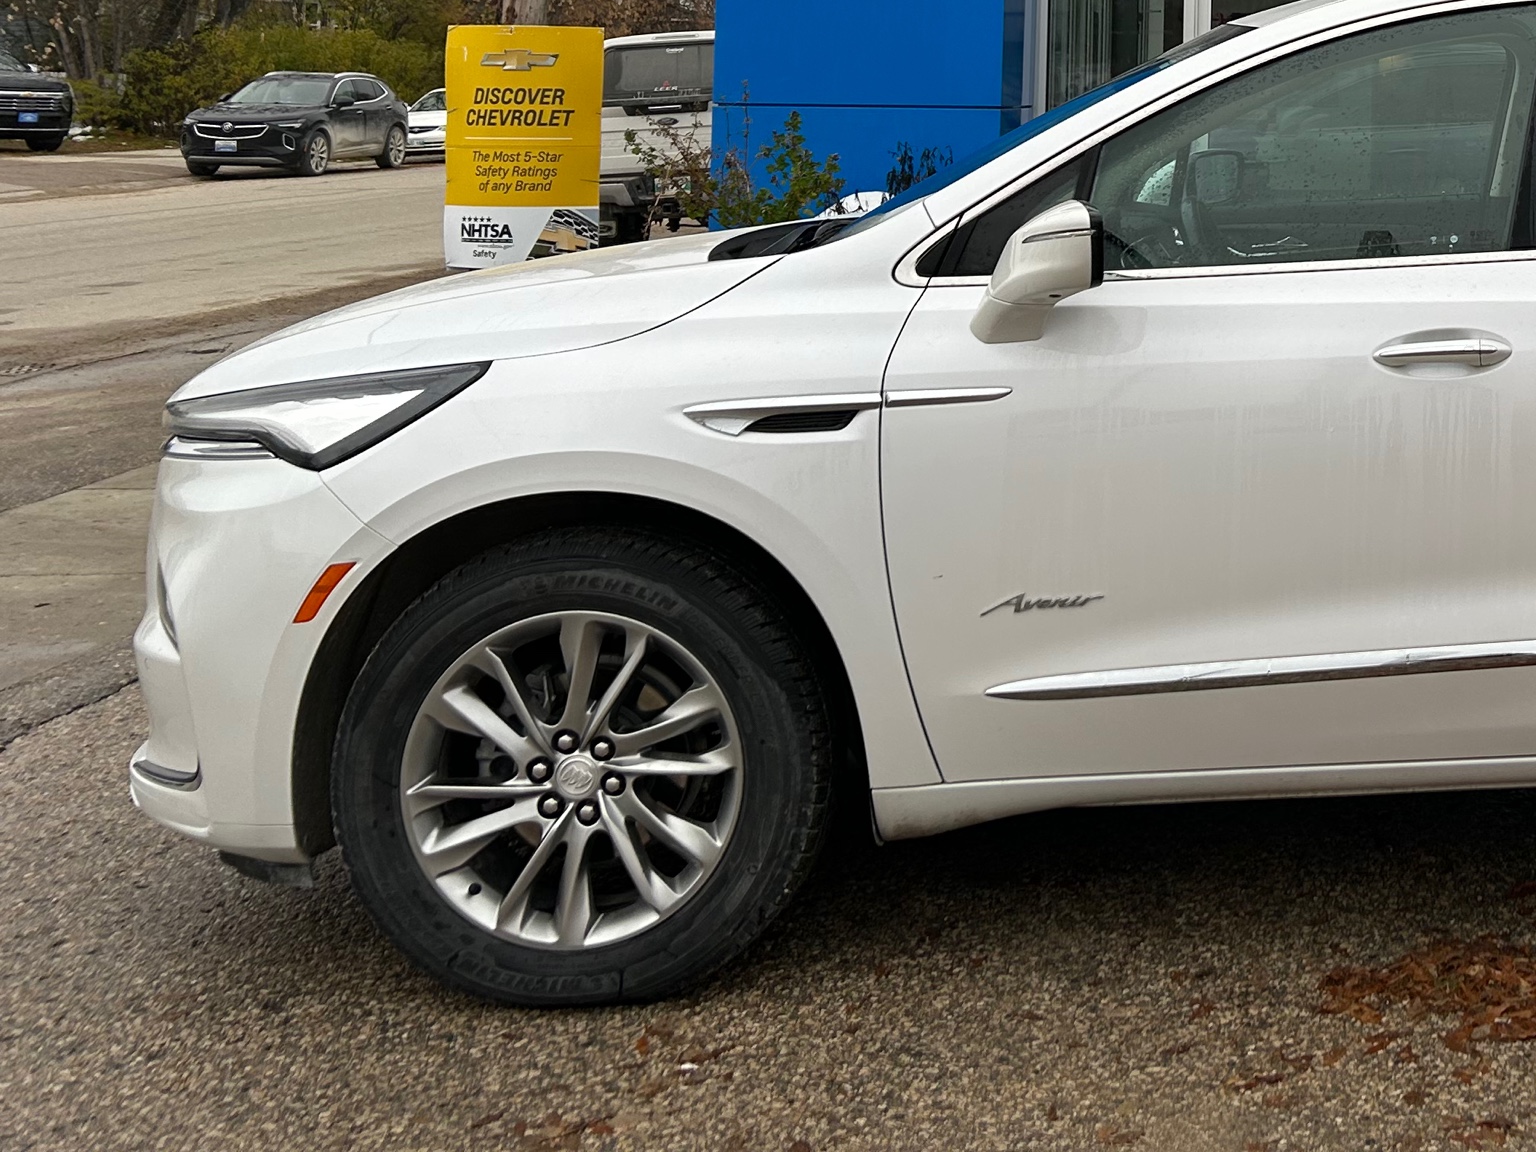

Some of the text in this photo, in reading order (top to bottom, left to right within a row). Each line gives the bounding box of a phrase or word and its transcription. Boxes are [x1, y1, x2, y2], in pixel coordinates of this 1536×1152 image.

[473, 88, 565, 105] DISCOVER
[466, 109, 575, 127] CHEVROLET
[472, 151, 563, 163] The Most 5-Star
[475, 166, 557, 179] Safety Ratings
[478, 180, 553, 194] of any Brand
[461, 223, 513, 238] NHTSA
[472, 249, 497, 259] Safety
[552, 574, 678, 611] MICHELIN
